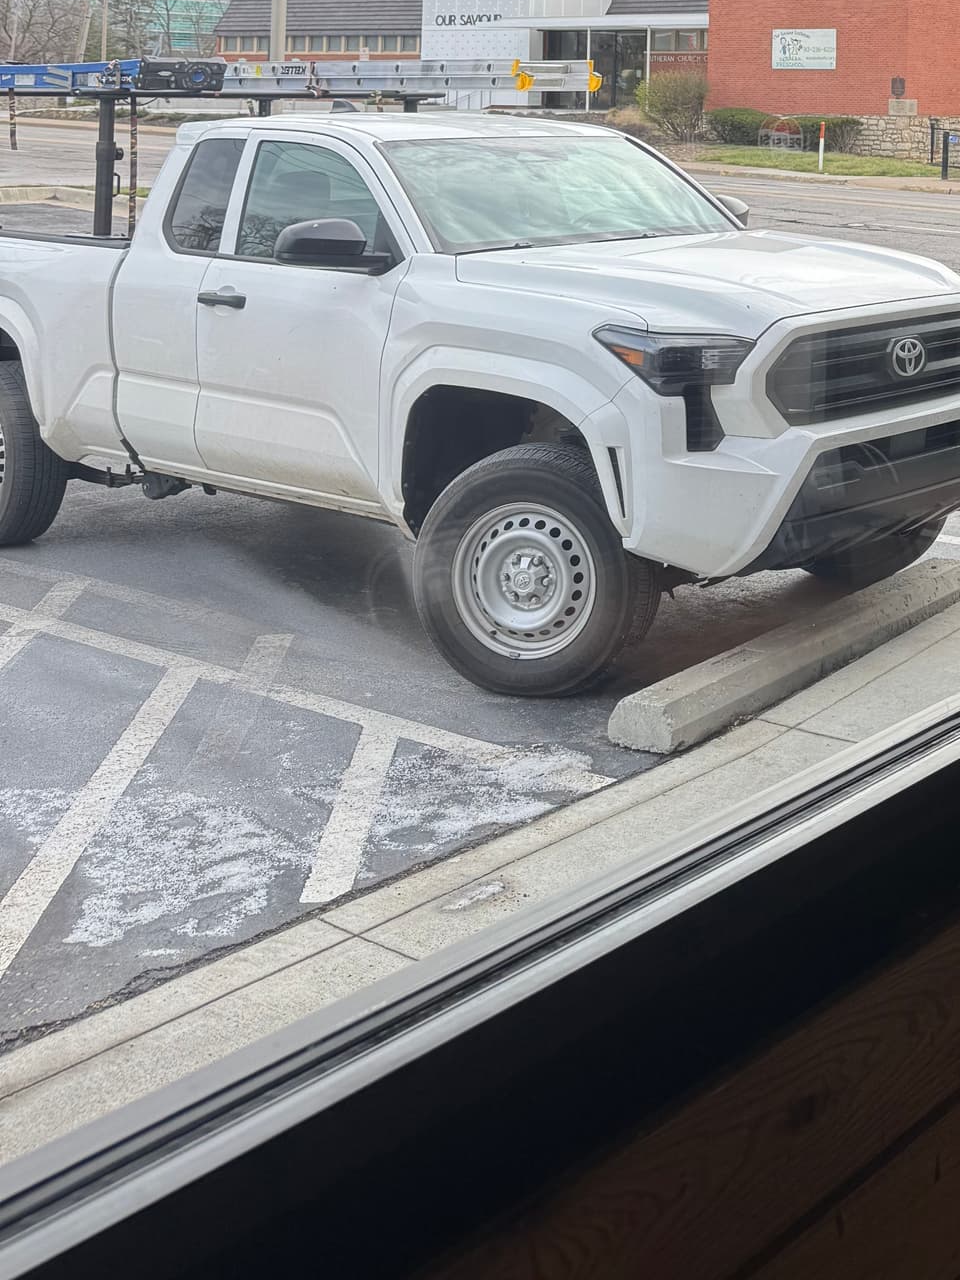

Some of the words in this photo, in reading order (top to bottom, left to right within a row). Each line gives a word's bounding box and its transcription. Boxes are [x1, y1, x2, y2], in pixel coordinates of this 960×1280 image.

[435, 14, 456, 26] OUR
[649, 55, 675, 63] UTHERAN
[280, 65, 307, 75] KELLER
